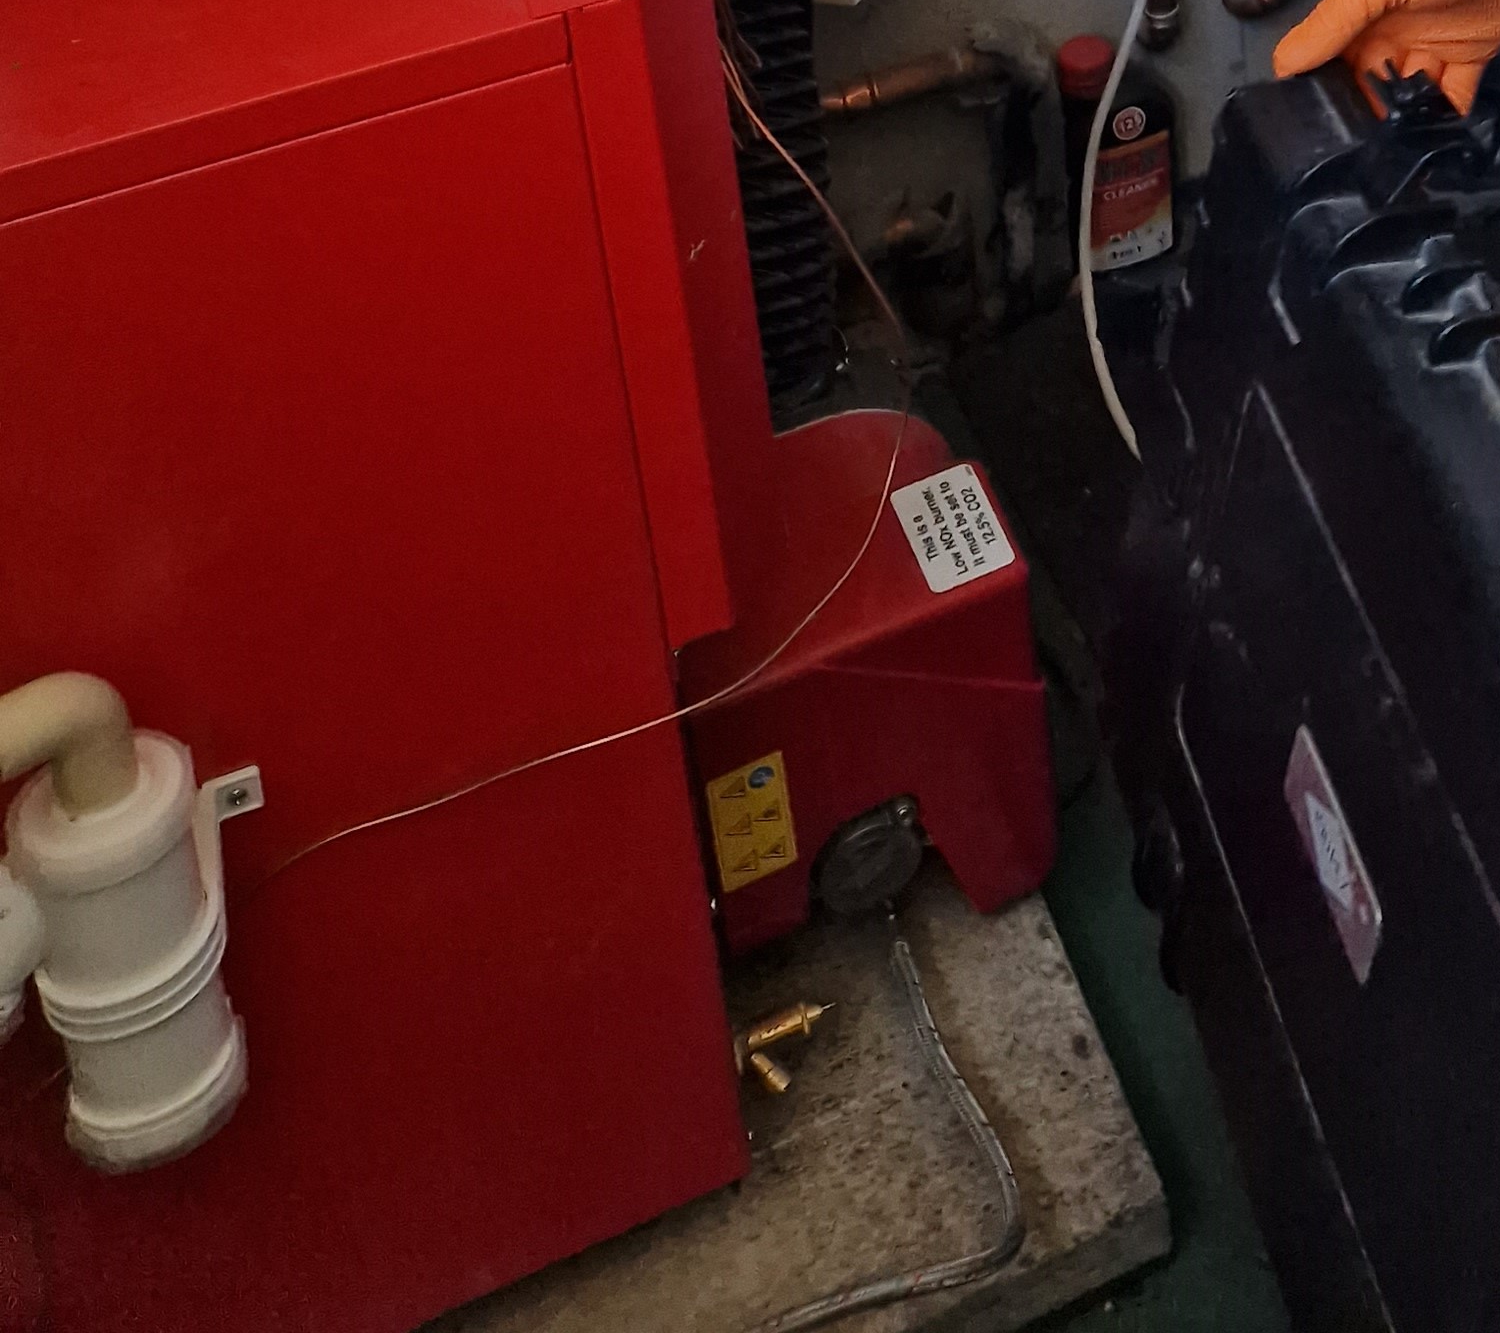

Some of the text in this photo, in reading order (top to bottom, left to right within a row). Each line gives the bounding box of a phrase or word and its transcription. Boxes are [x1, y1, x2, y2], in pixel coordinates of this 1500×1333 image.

[960, 487, 981, 512] CO2
[939, 481, 986, 567] It must be set to
[913, 515, 940, 562] This is a
[940, 525, 956, 551] NOx
[952, 551, 969, 576] Low
